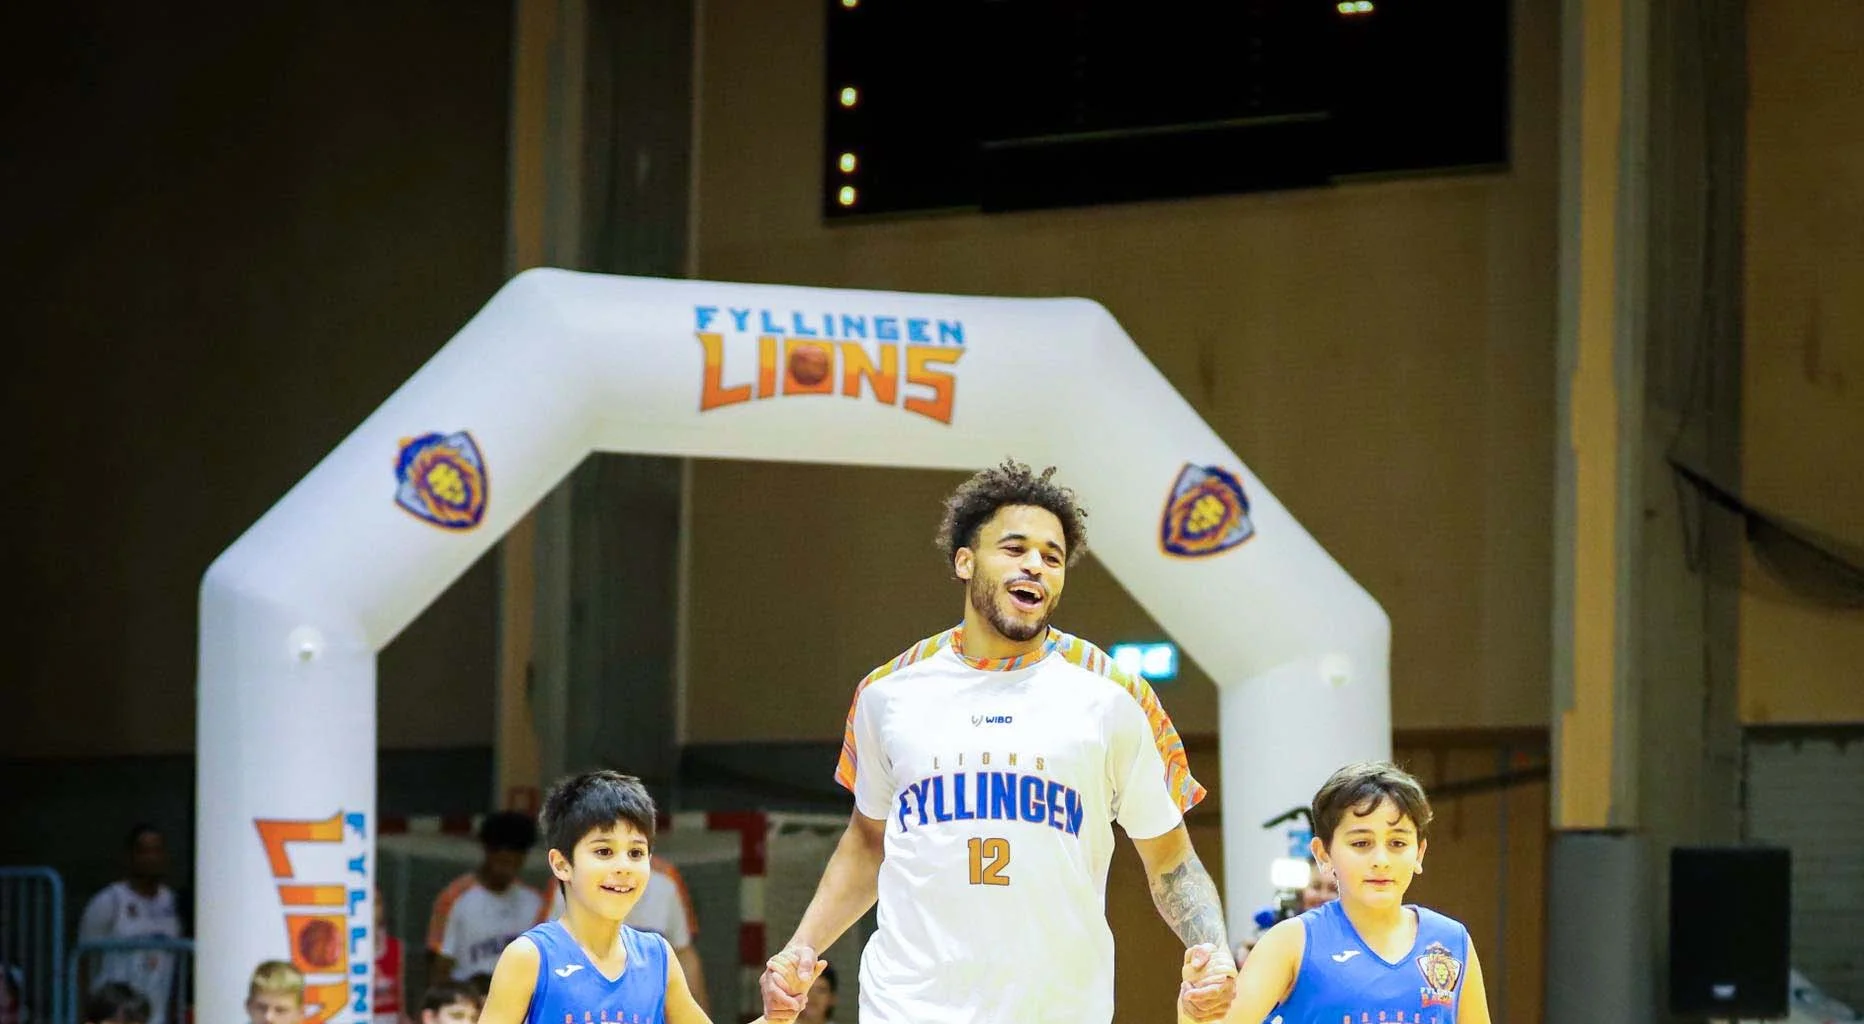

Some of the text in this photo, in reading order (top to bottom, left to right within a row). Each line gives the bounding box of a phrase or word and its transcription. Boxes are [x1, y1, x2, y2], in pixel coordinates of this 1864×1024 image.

[694, 304, 965, 344] FYLLINGEN
[694, 331, 967, 425] LIONS
[985, 716, 1013, 724] WIBO
[933, 752, 1044, 771] LIONS
[899, 771, 1084, 839] FYLLINGEN
[967, 837, 1011, 886] 12
